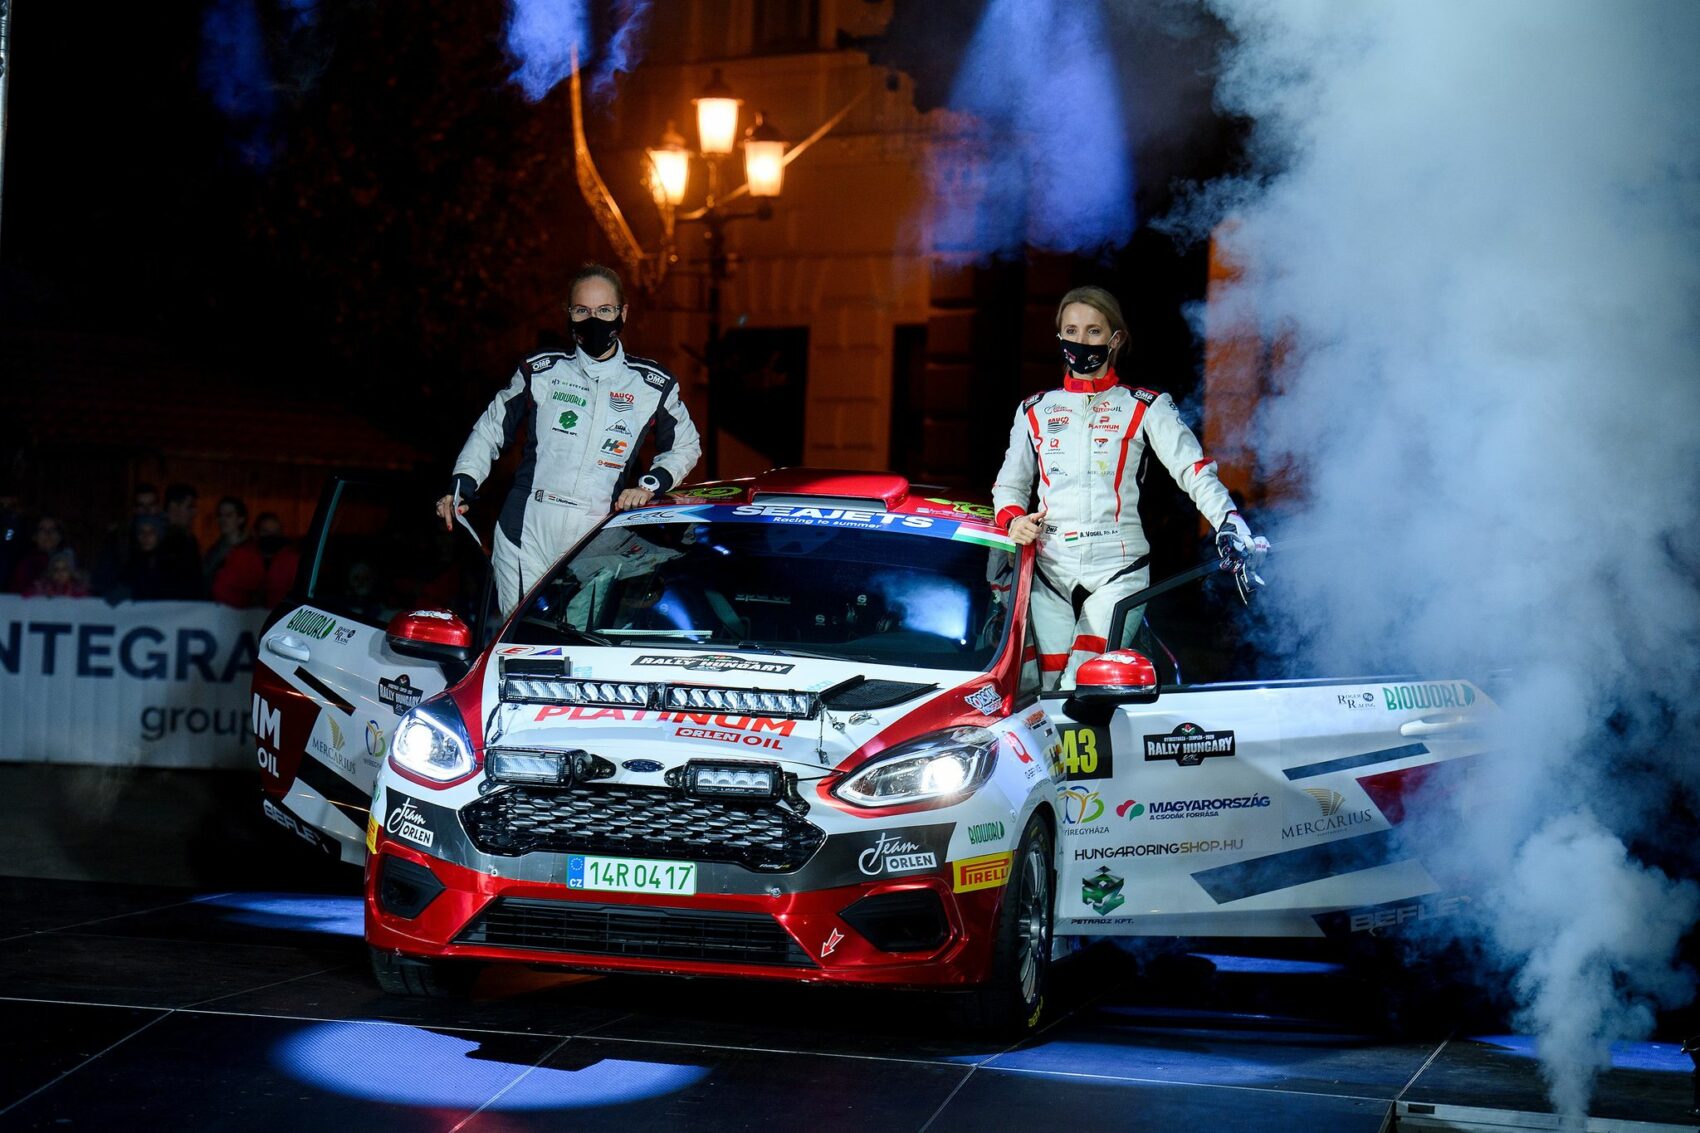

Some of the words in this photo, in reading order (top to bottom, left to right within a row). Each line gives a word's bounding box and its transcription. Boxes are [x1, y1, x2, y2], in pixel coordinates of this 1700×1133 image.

[732, 505, 934, 529] SEAJETS
[773, 516, 814, 525] Racing
[833, 520, 881, 529] summer
[639, 657, 695, 666] RALLY
[699, 660, 789, 673] HUNGARY
[679, 728, 740, 743] ORLEN
[742, 735, 783, 751] OIL
[1148, 741, 1180, 756] RALLY
[1183, 736, 1233, 754] HUNGARY
[312, 737, 357, 776] MERCARIUS
[1063, 728, 1098, 774] 43
[257, 747, 280, 779] OIL
[1149, 792, 1271, 814] MAGYARORSZÁG
[1186, 810, 1219, 819] FORRÁSA
[1281, 809, 1372, 840] MERCARIUS
[402, 824, 432, 845] ORLEN
[1074, 839, 1244, 861] HUNGARORINGSHOP.HU
[889, 855, 934, 869] ORLEN
[569, 879, 583, 888] CZ
